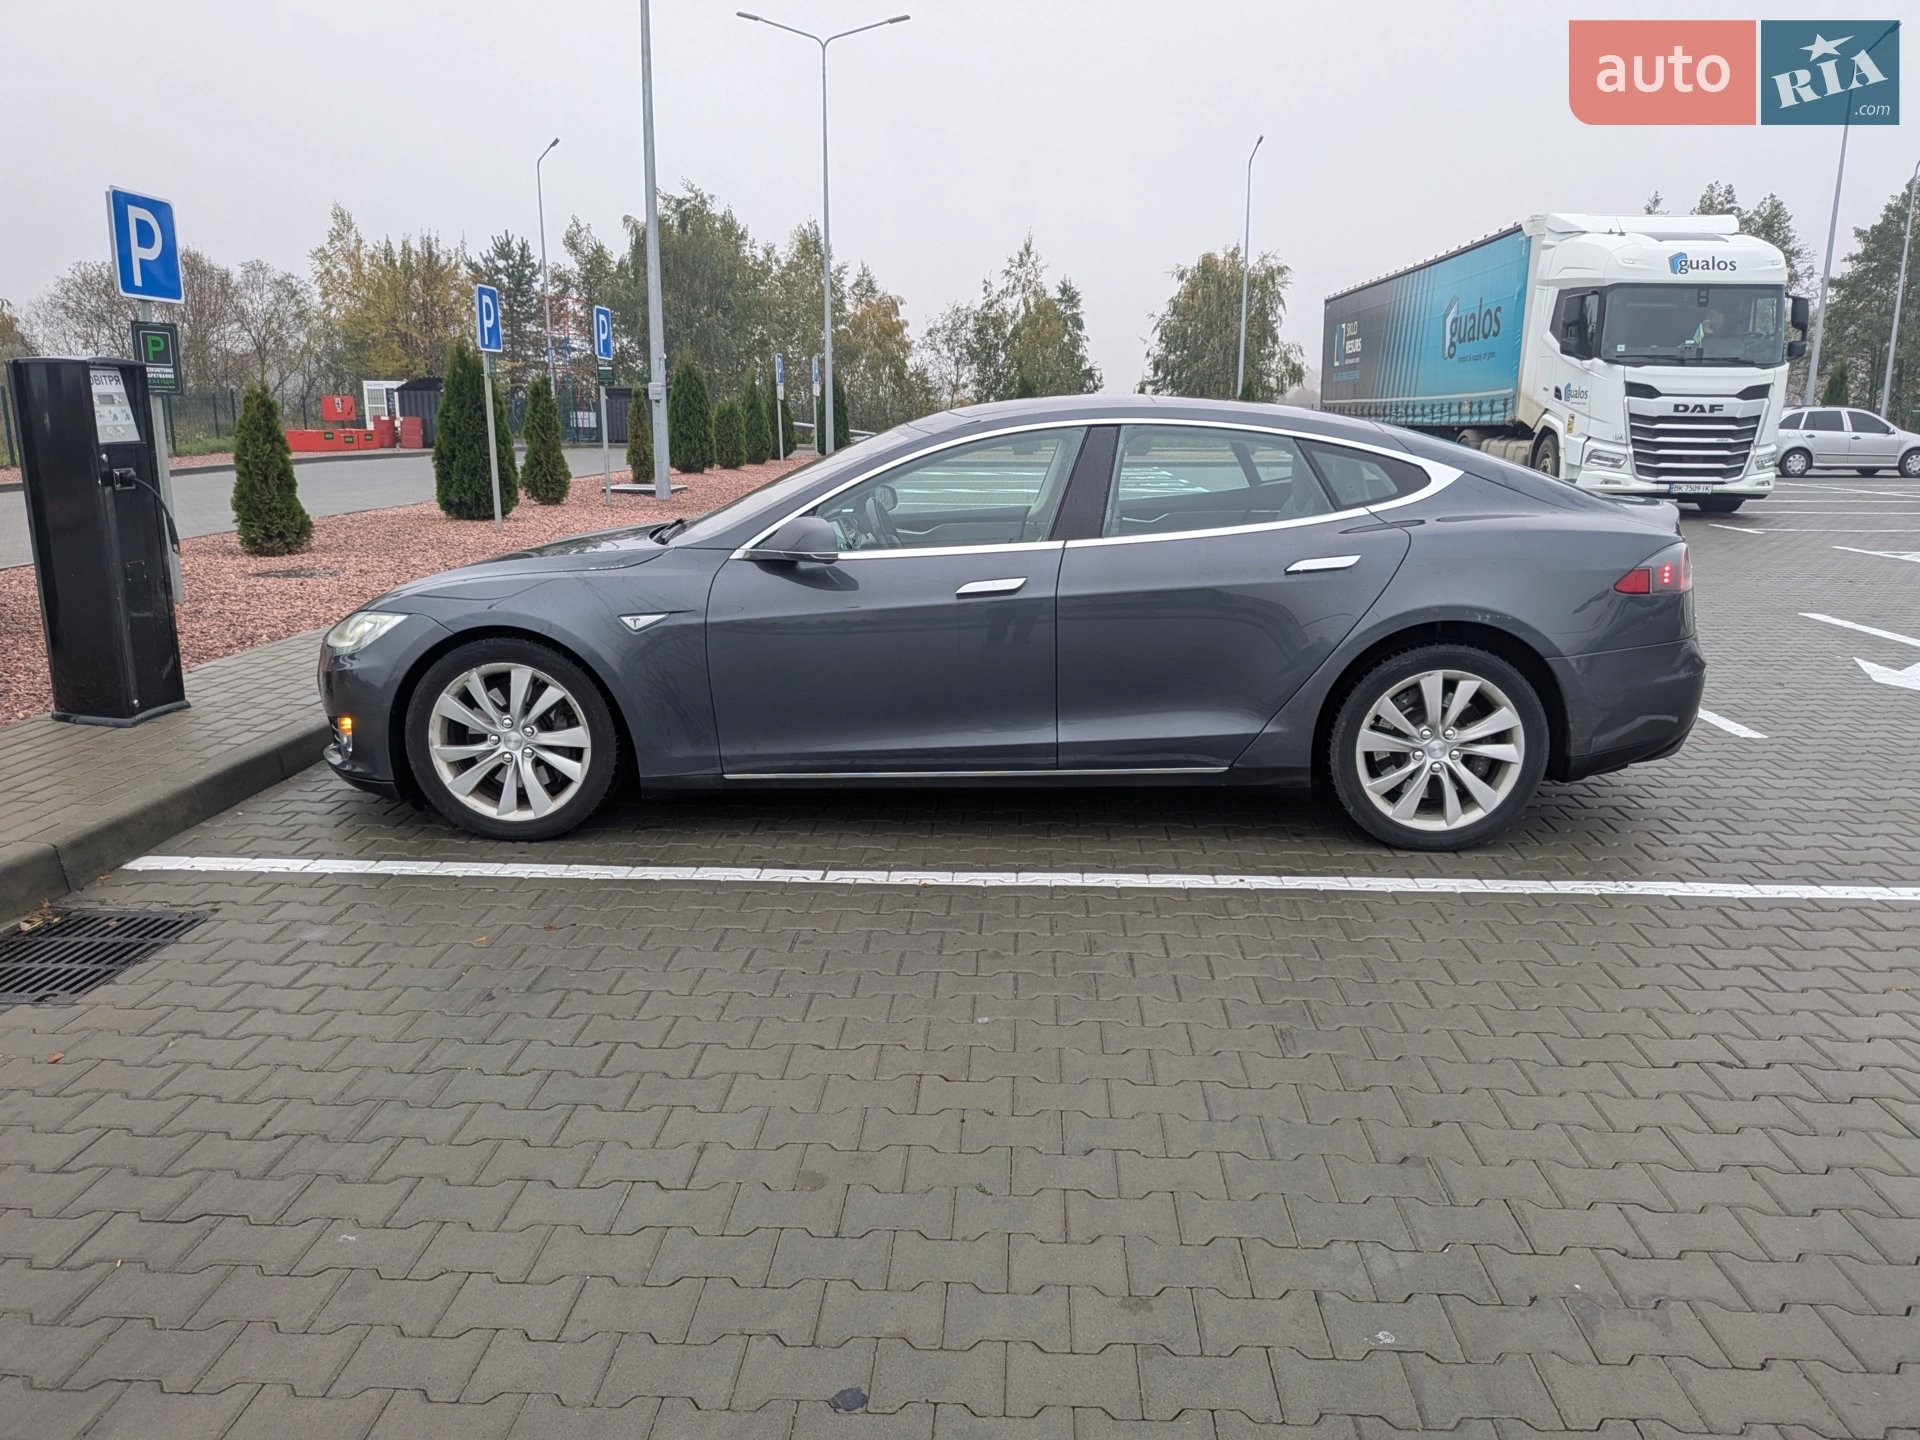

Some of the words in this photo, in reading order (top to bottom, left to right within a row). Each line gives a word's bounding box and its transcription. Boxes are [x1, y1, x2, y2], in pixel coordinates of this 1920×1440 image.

[127, 204, 162, 287] P
[1678, 256, 1737, 275] gualos
[482, 295, 494, 345] P
[599, 314, 608, 353] P
[1447, 297, 1502, 359] gualos
[146, 335, 165, 361] P
[1673, 404, 1724, 413] DAF
[1685, 484, 1700, 492] 7509
